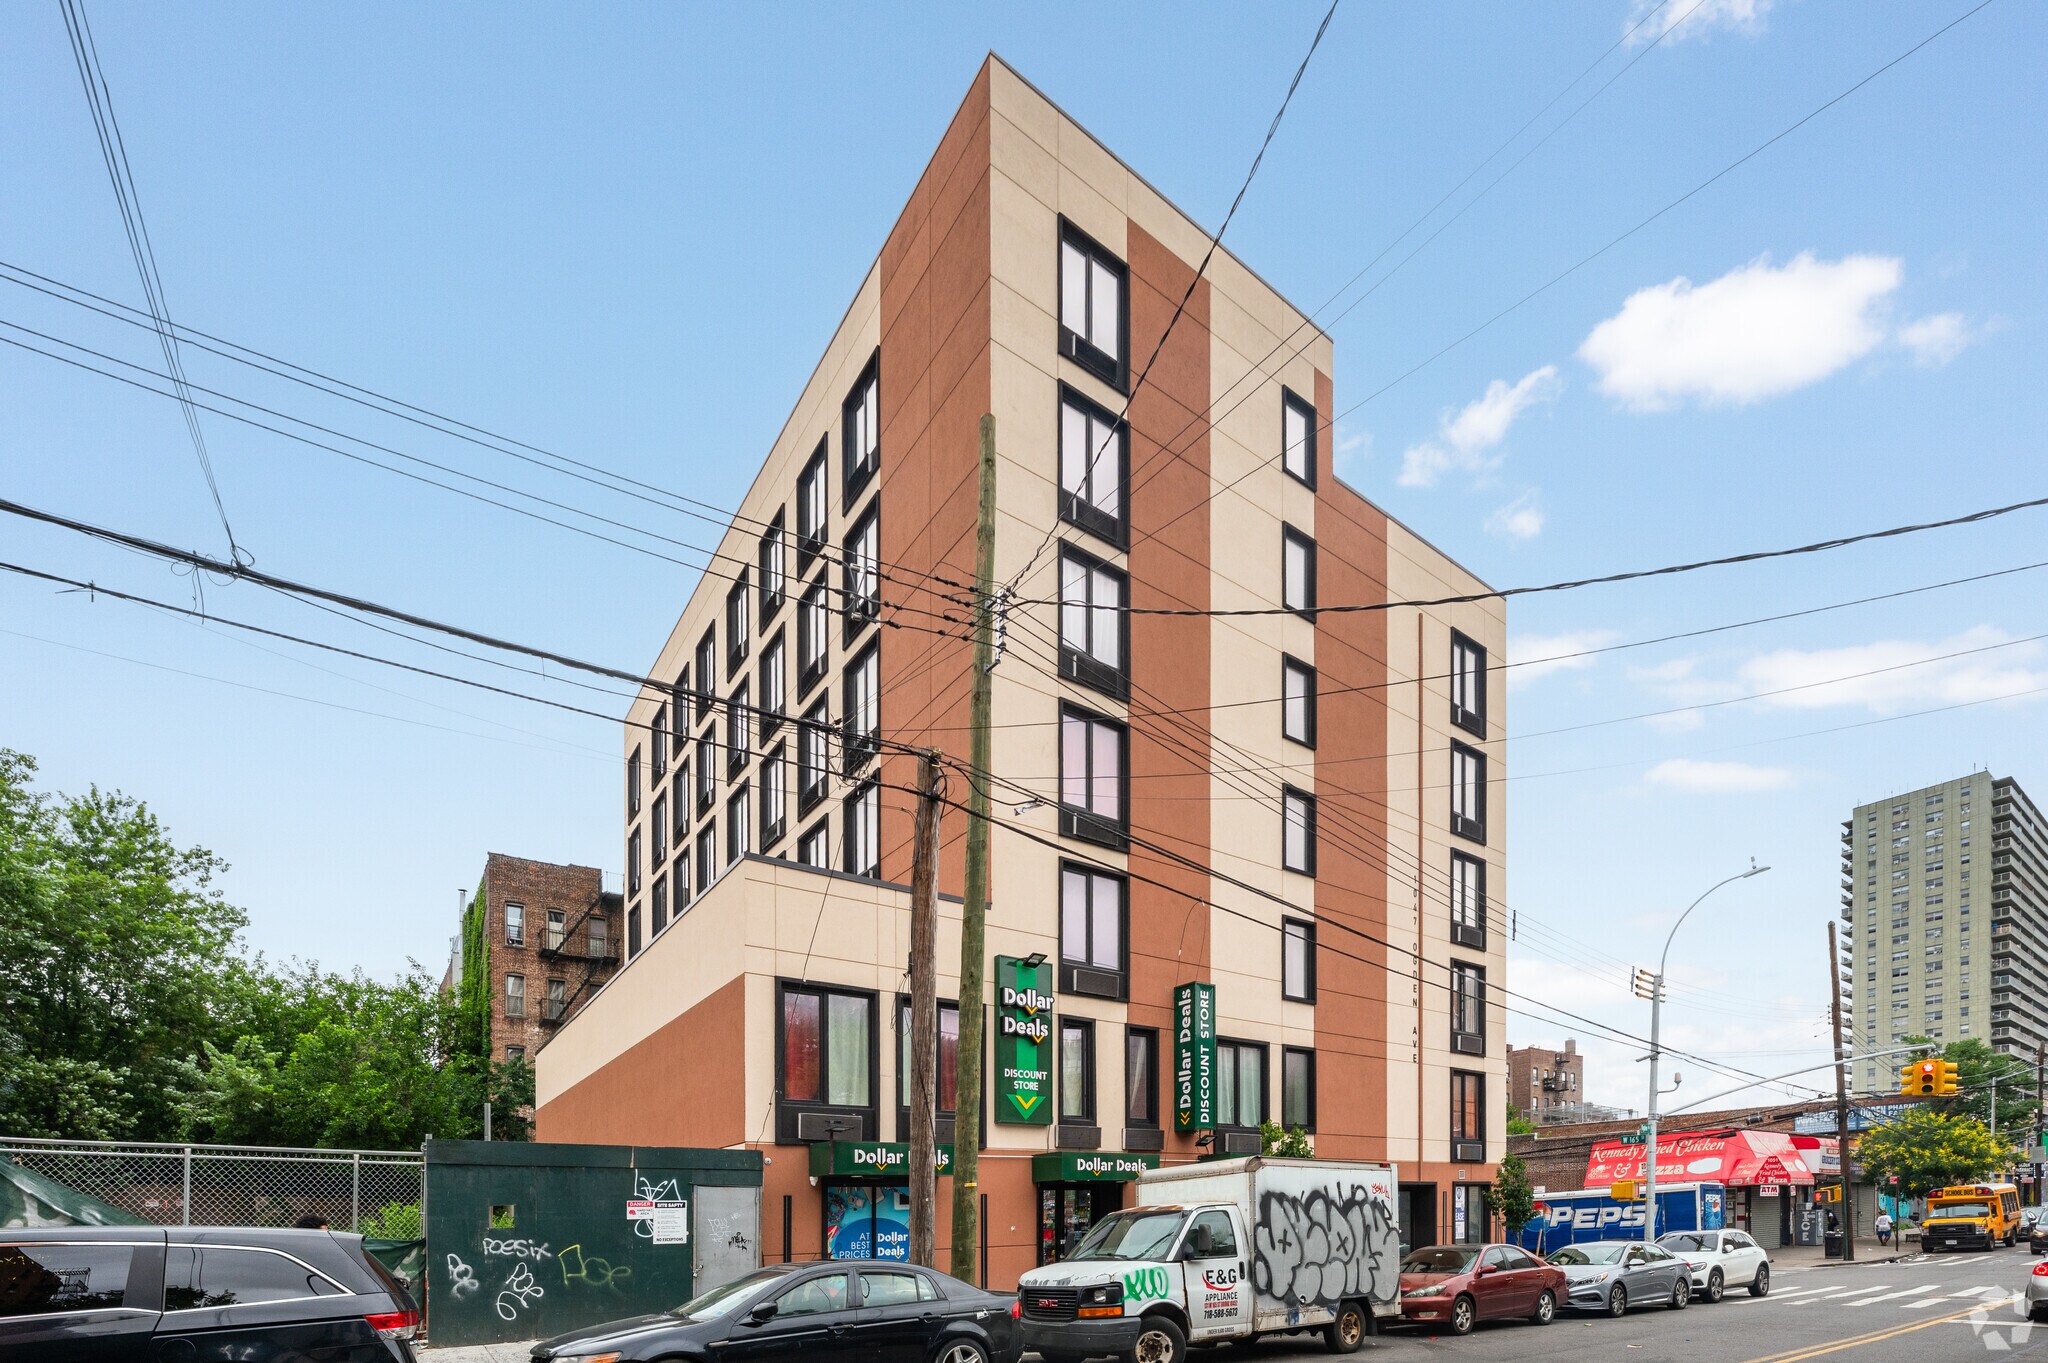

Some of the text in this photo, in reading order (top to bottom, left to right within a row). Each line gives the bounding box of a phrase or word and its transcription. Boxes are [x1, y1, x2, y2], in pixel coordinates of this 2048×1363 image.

[1004, 987, 1054, 1010] Dollar
[1004, 1016, 1049, 1037] Deals
[1178, 988, 1192, 1109] Dollar Deals
[1200, 990, 1210, 1123] DISCOUNT STORE
[1004, 1068, 1048, 1081] DISCOUNT
[1013, 1081, 1039, 1091] STORE
[1629, 1136, 1640, 1144] 165
[854, 1147, 904, 1165] Dollar
[1592, 1138, 1725, 1163] Kennedy Fied Chicken
[1077, 1157, 1147, 1171] Dollar Deals
[1614, 1162, 1632, 1178] &
[1636, 1161, 1684, 1177] Pzza
[1761, 1185, 1778, 1193] ATM
[1549, 1204, 1659, 1228] PEPS
[1801, 1211, 1811, 1241] ICE
[859, 1232, 870, 1240] AT
[877, 1232, 908, 1242] Dollar
[850, 1241, 870, 1250] BEST
[877, 1245, 905, 1256] Deals
[839, 1250, 871, 1259] PRICES
[1205, 1268, 1237, 1285] E&G
[1205, 1291, 1238, 1302] APPLIANCE
[1038, 1299, 1058, 1308] GMC
